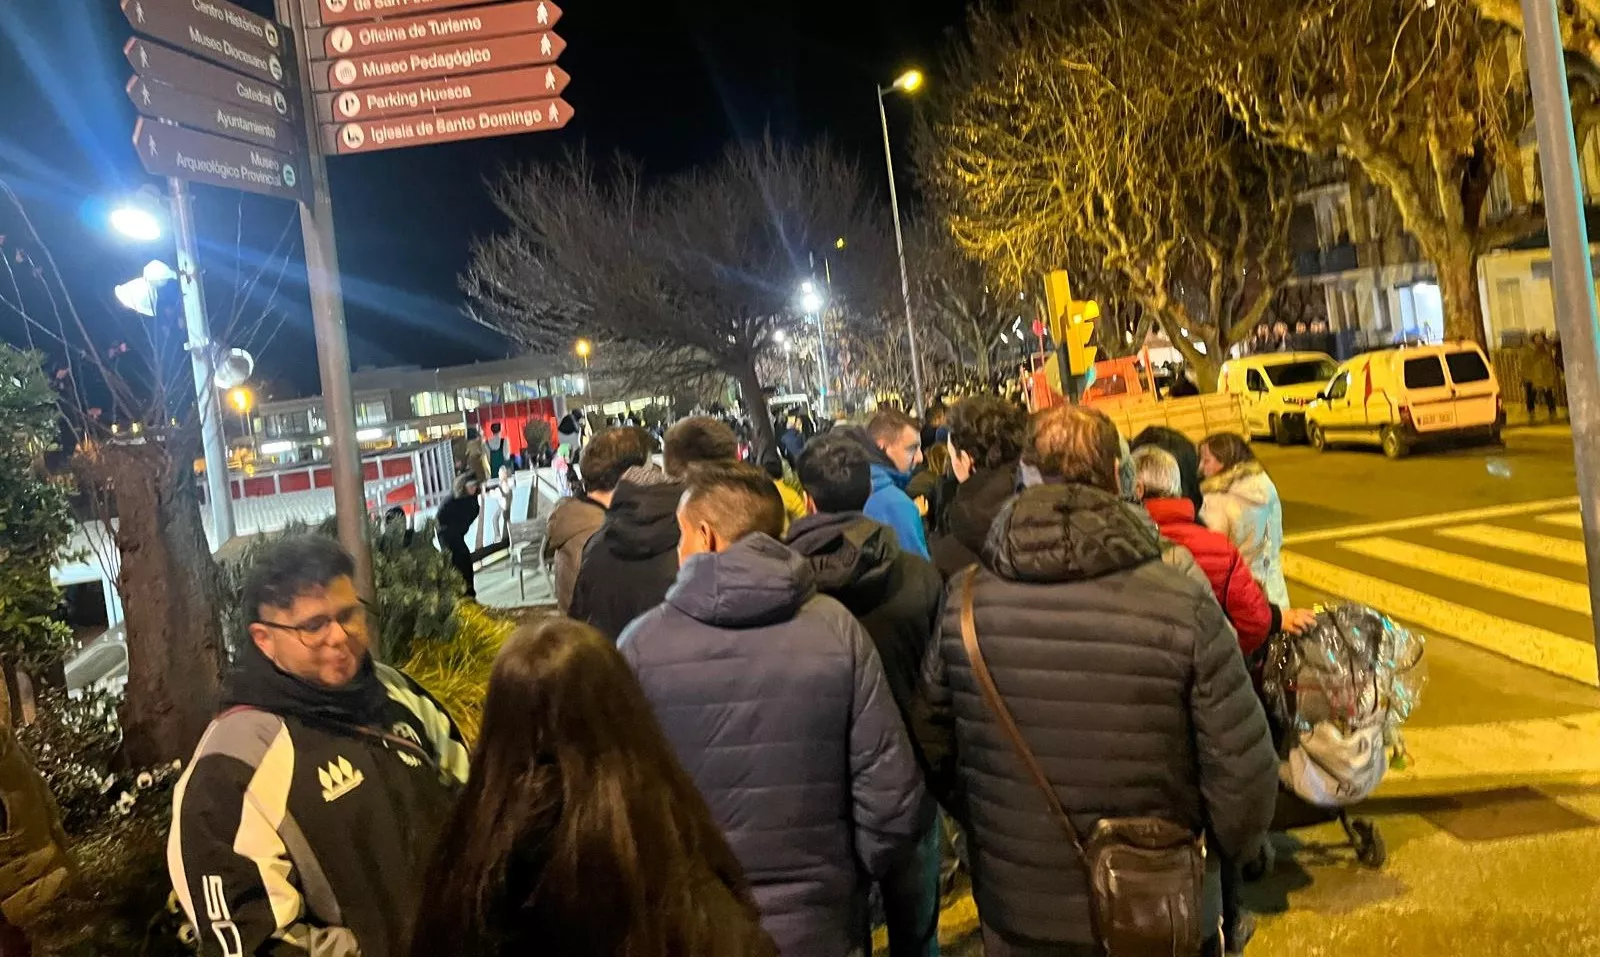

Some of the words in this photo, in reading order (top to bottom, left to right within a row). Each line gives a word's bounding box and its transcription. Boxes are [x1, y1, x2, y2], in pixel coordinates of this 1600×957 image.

[192, 0, 224, 21] Centro
[224, 8, 263, 37] Histórico
[359, 24, 406, 46] Oficina
[409, 24, 427, 39] de
[427, 16, 482, 35] Turismo
[189, 24, 222, 52] Museo
[222, 39, 268, 71] Diocesano
[362, 57, 408, 77] Museo
[411, 47, 491, 72] Pedagógico
[236, 81, 273, 106] Catedral
[367, 88, 418, 110] Parking
[420, 85, 472, 103] Huesca
[217, 109, 276, 138] Ayuntamiento
[370, 123, 414, 144] Iglesia
[416, 121, 433, 136] de
[436, 115, 476, 133] Santo
[479, 108, 542, 130] Domingo
[176, 151, 240, 179] Arqueológico
[240, 165, 282, 187] Provincial
[250, 151, 280, 171] Museo
